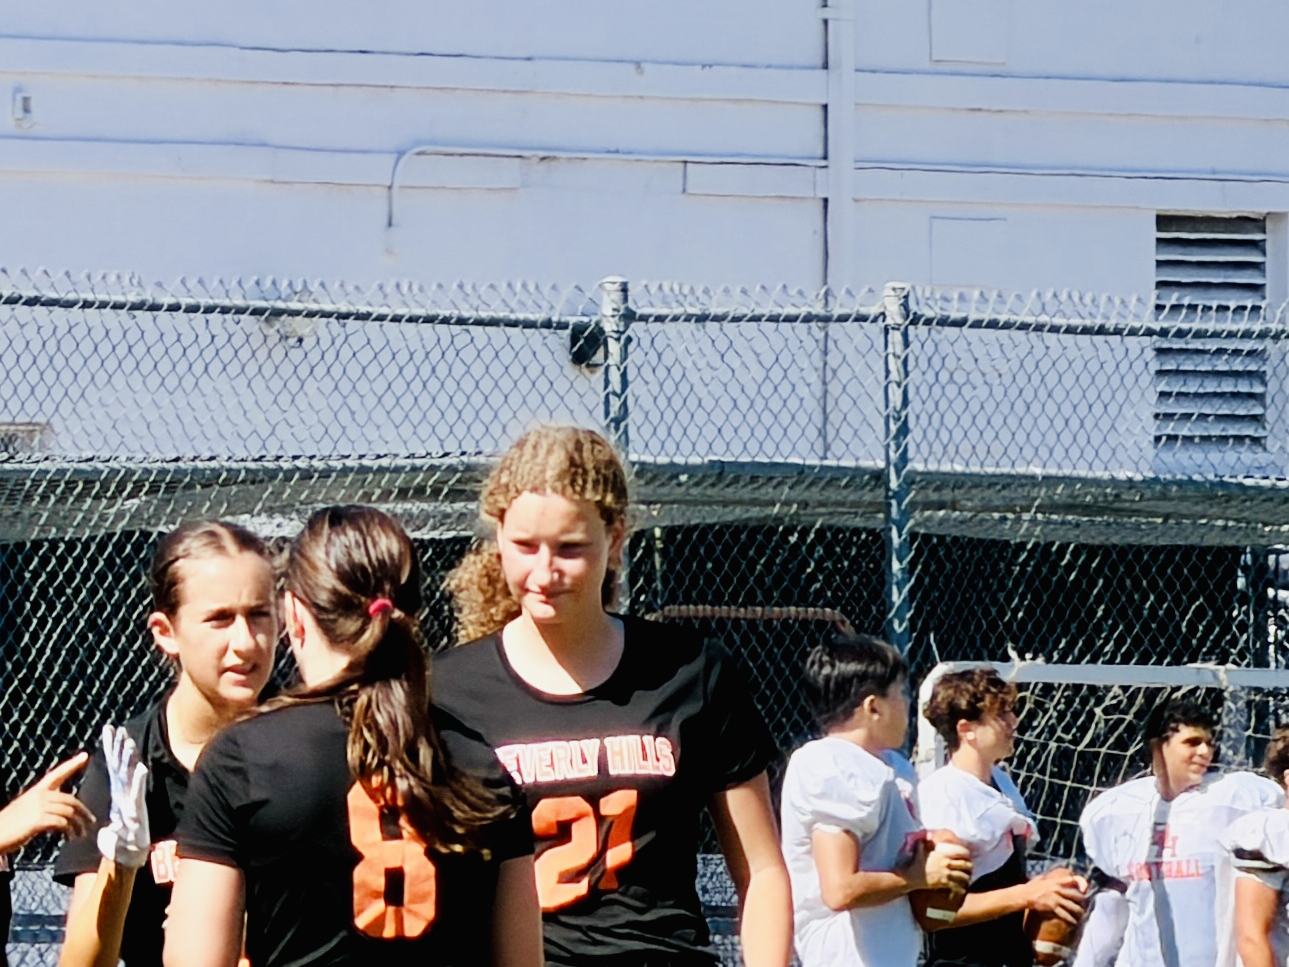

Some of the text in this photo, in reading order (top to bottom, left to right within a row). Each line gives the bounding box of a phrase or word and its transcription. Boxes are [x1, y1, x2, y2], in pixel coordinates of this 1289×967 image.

[495, 735, 676, 785] EVERLY HILLS
[531, 788, 638, 913] 21
